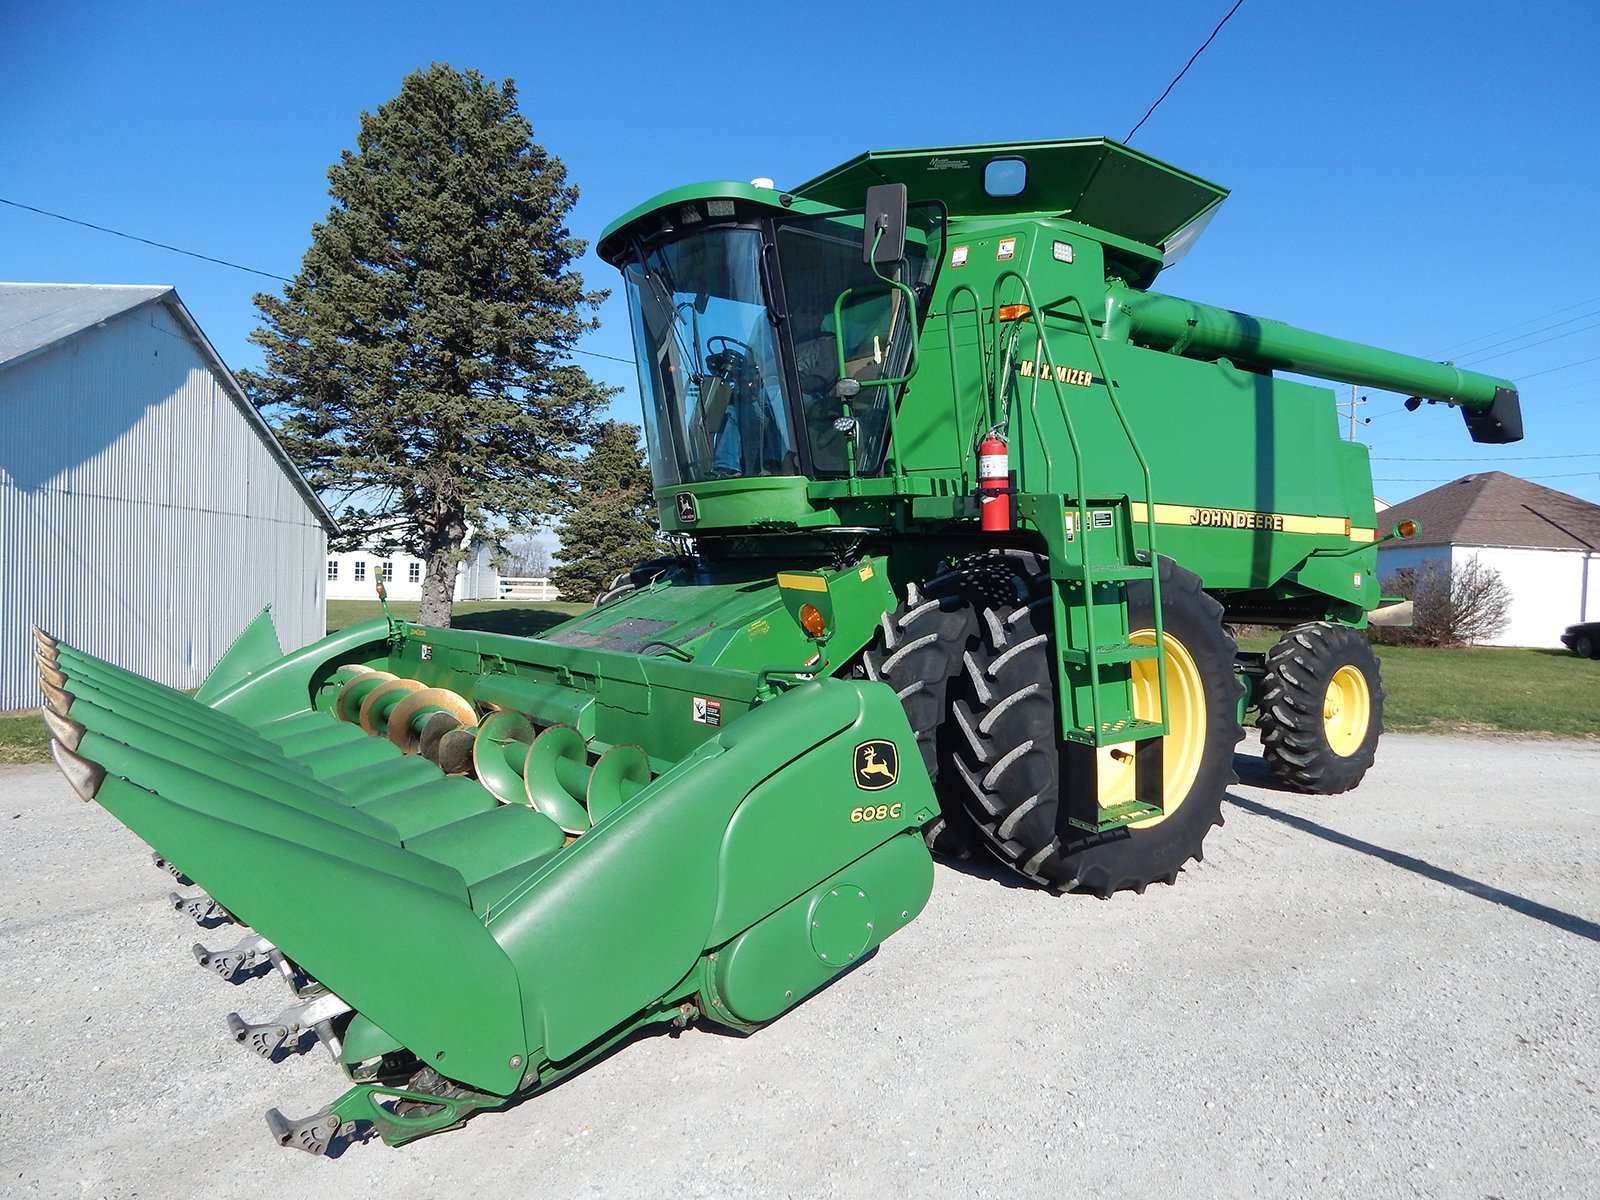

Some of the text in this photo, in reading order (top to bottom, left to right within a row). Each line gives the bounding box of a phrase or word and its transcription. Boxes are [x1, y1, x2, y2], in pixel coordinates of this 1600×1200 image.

[1020, 360, 1093, 387] MXMIZER
[1190, 509, 1283, 531] JOHN DEERE
[850, 803, 902, 823] 608C
